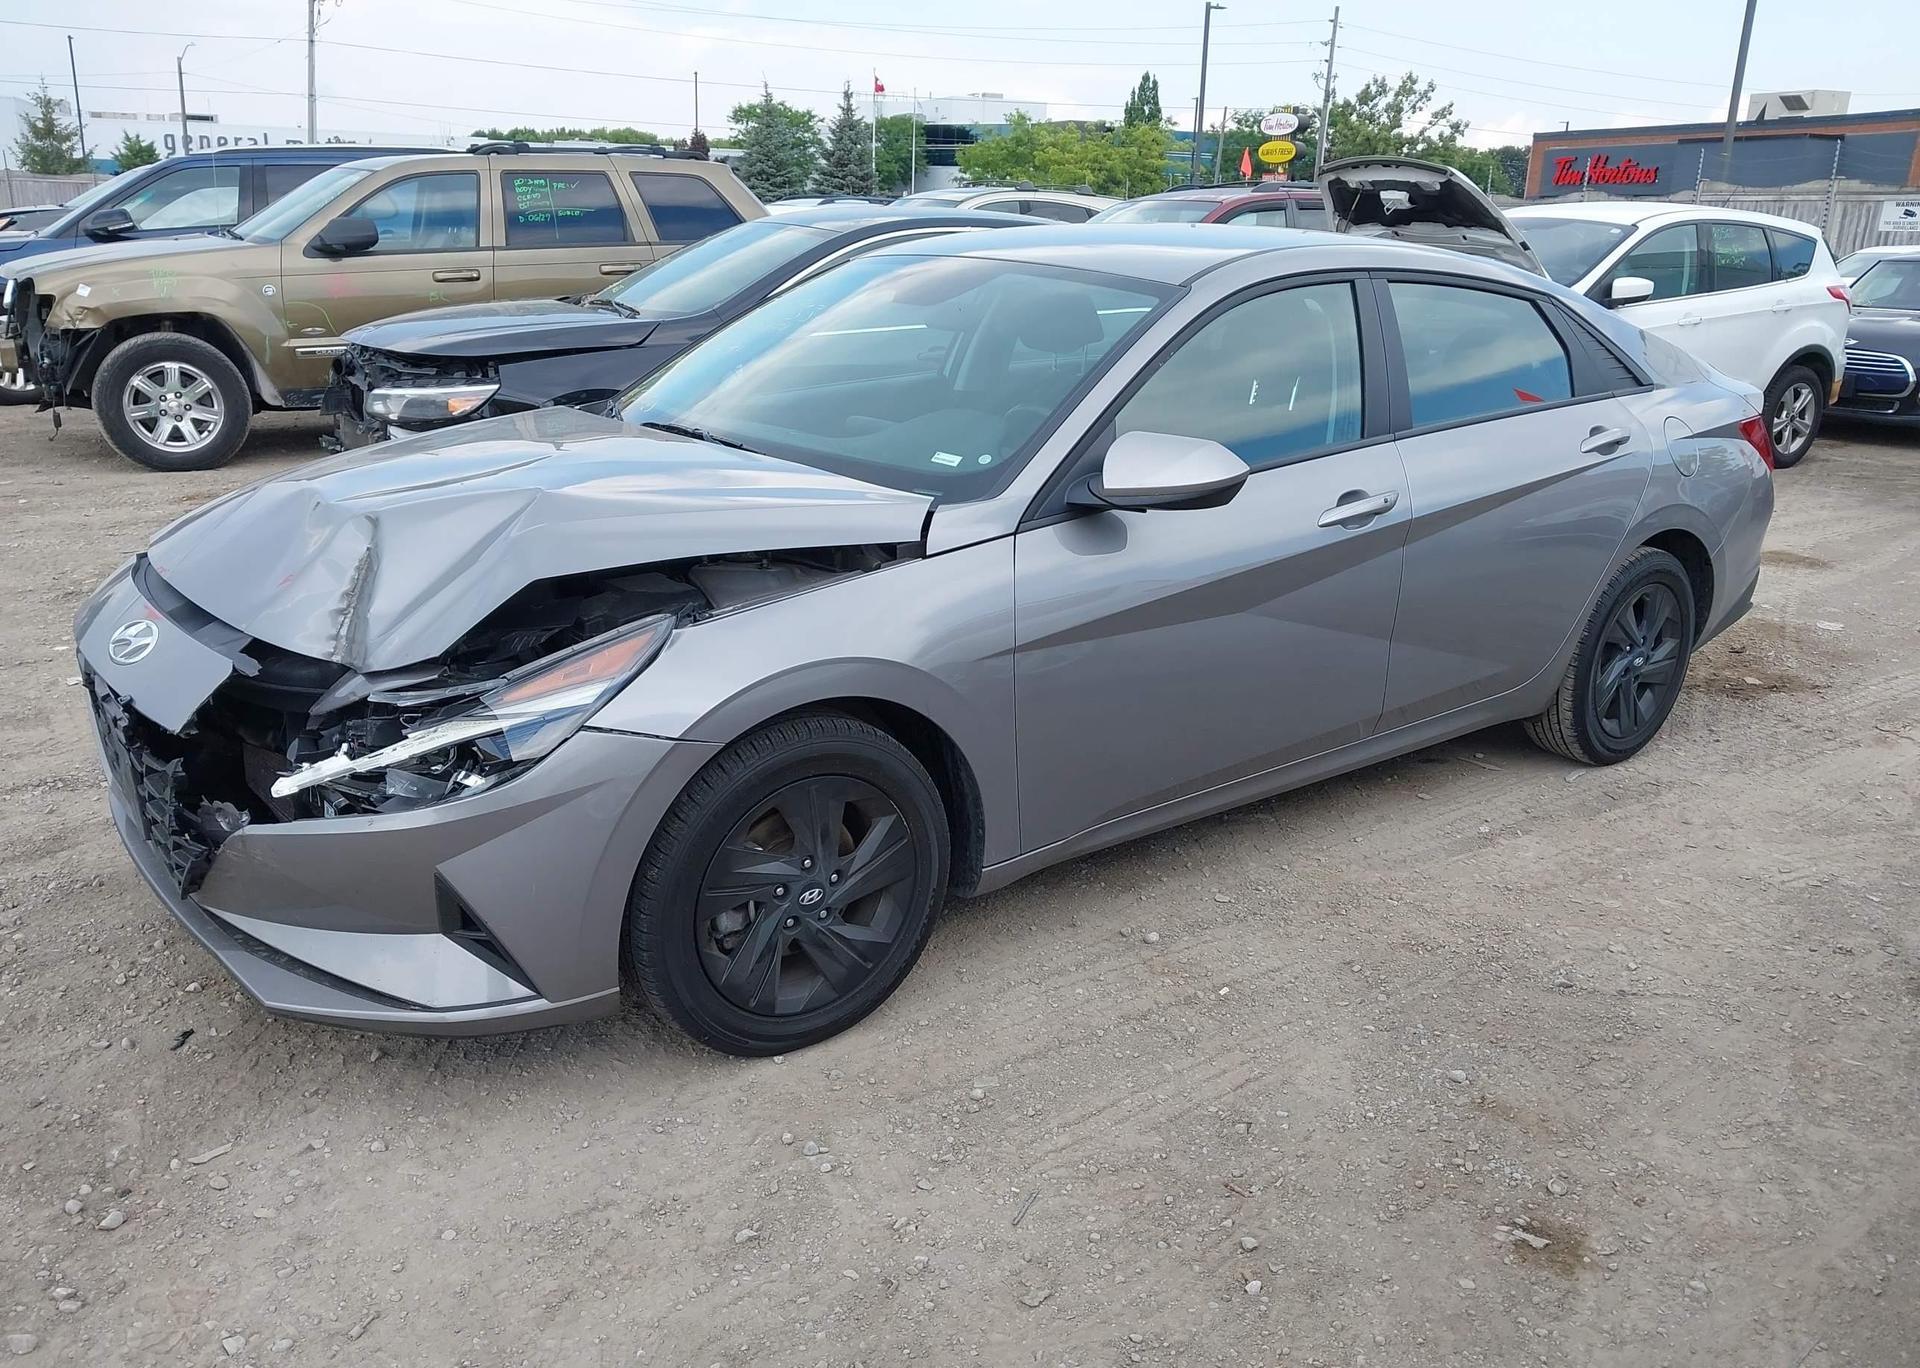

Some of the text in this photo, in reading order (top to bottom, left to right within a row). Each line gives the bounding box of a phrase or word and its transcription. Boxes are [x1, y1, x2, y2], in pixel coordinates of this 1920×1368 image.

[163, 132, 268, 157] general
[1552, 154, 1659, 185] Tim Hortons
